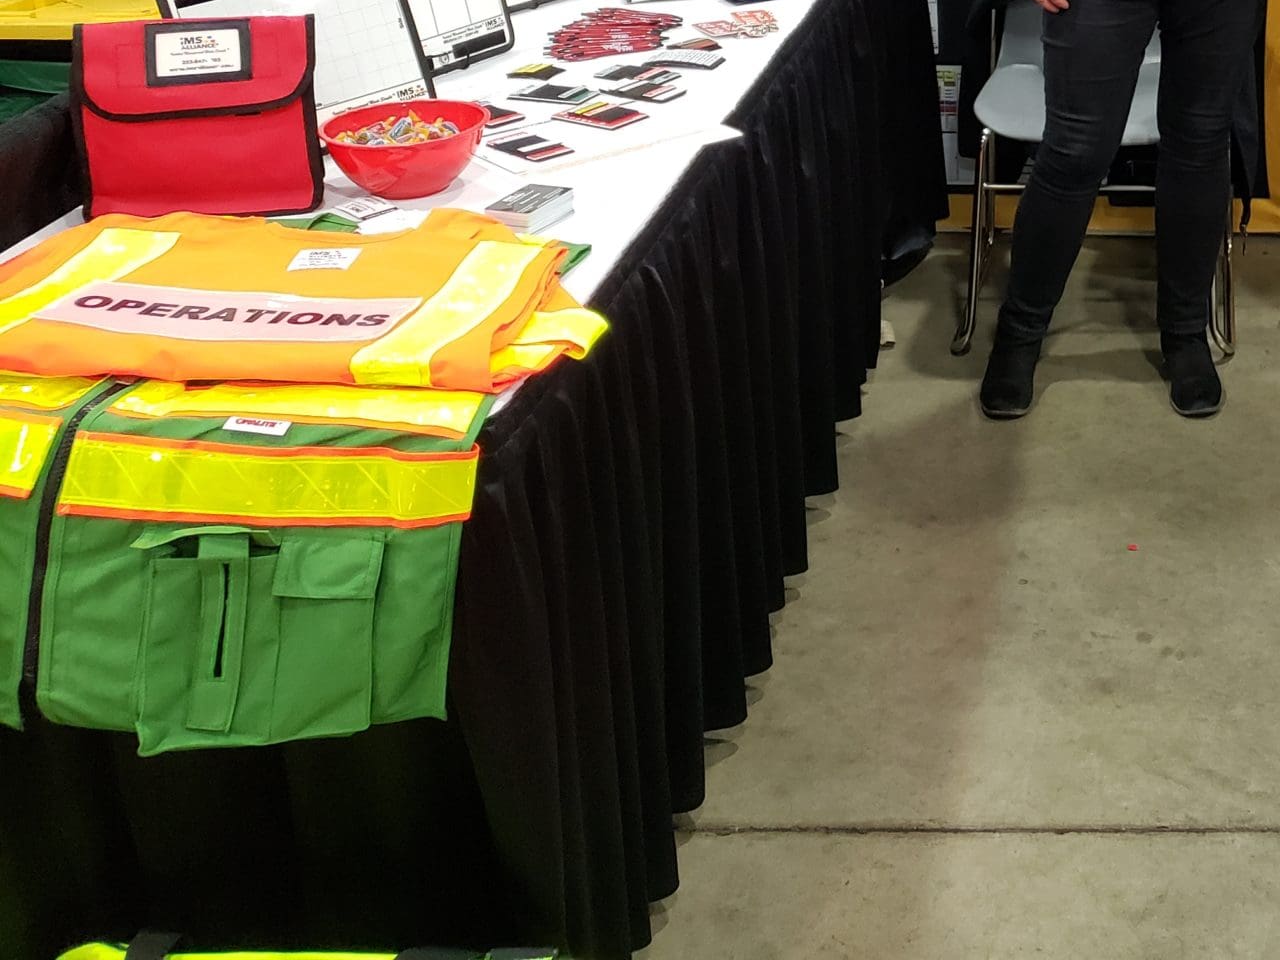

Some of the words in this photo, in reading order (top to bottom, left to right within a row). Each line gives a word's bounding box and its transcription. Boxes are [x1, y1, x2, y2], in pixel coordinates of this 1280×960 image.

[485, 18, 498, 27] IMS
[179, 35, 203, 45] IMS
[396, 86, 415, 98] IMS
[73, 294, 392, 328] OPERATIONS
